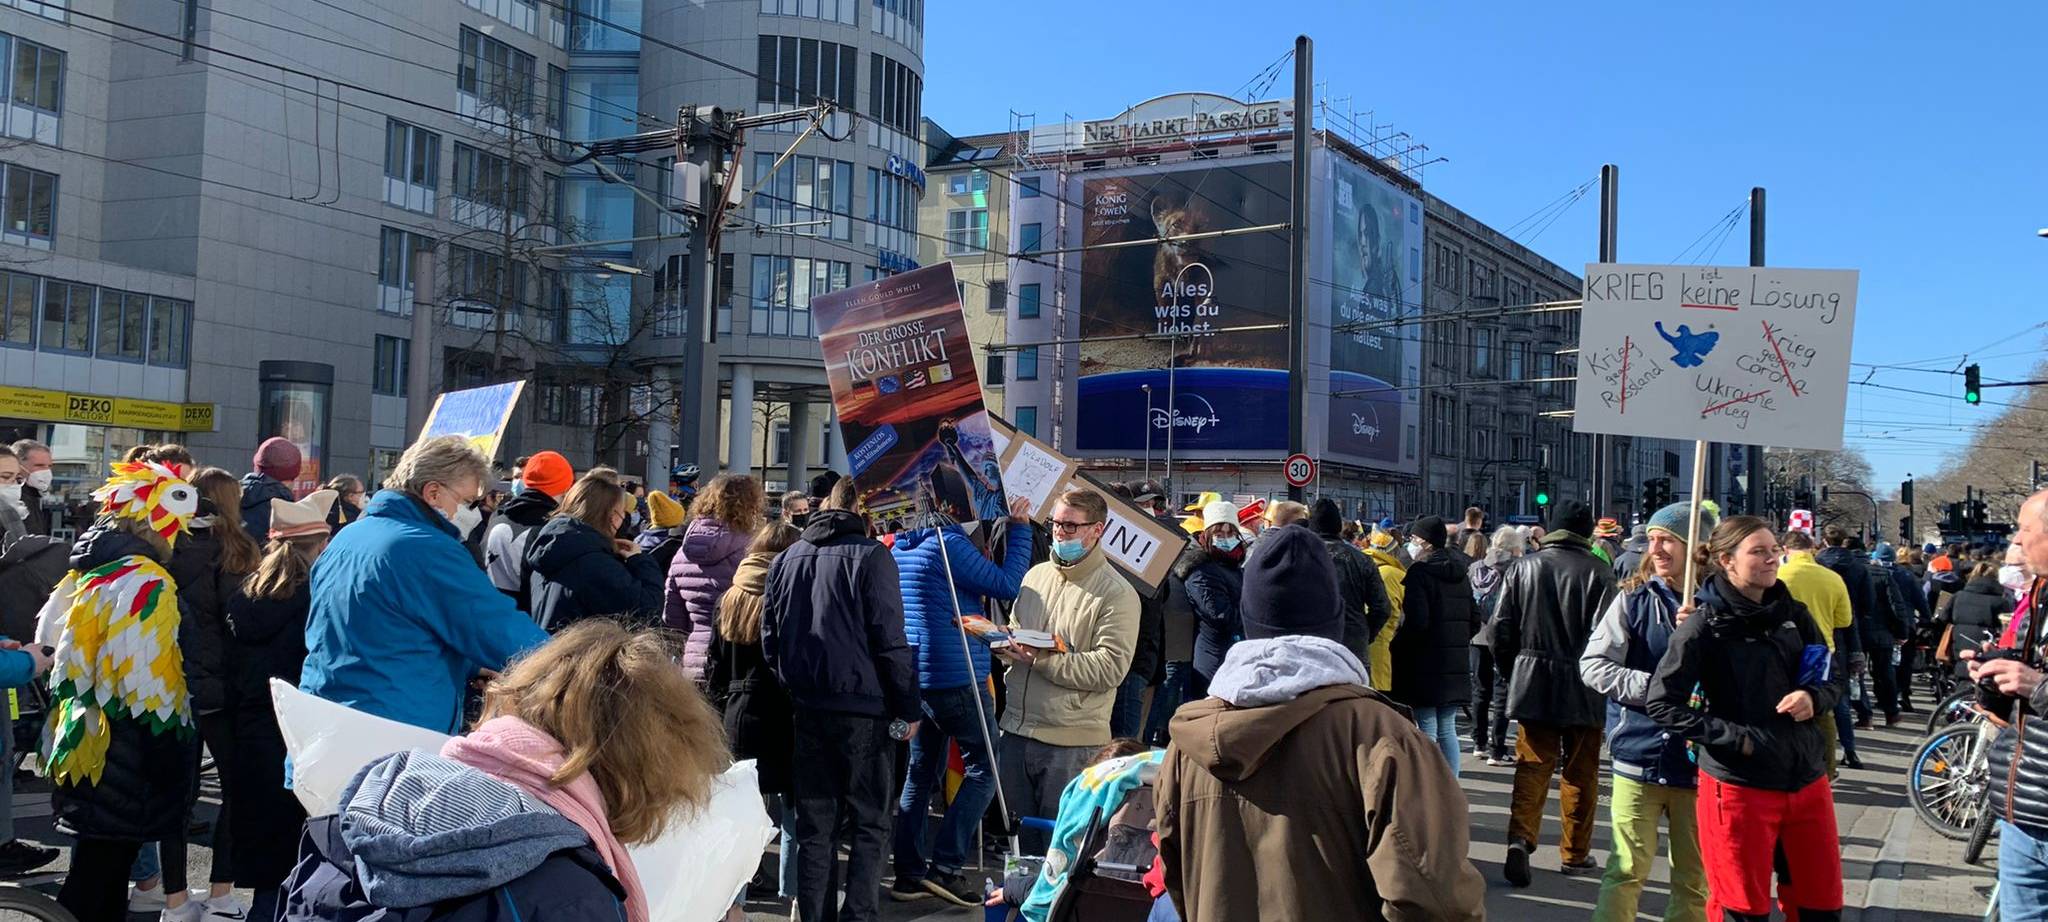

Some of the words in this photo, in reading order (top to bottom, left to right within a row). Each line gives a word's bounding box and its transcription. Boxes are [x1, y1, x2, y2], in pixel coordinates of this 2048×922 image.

[1084, 118, 1188, 142] NEUMARKT
[1194, 107, 1279, 131] PASSAGE
[1587, 271, 1664, 301] KRIEG
[1700, 268, 1724, 281] ist
[868, 290, 894, 301] GOULD
[896, 282, 921, 294] WHITE
[1681, 272, 1740, 306] keine
[1750, 274, 1841, 324] Lösung
[1154, 304, 1191, 318] was
[1196, 301, 1219, 316] du
[1340, 302, 1351, 319] du
[858, 332, 881, 348] DER
[883, 320, 926, 341] GROSSE
[1761, 323, 1817, 367] Krieg
[846, 328, 949, 381] KONFLIKT
[1585, 341, 1644, 376] Krieg
[1755, 348, 1796, 370] gegen
[1600, 358, 1664, 408] Russland
[1605, 362, 1633, 386] gegen
[1735, 354, 1809, 395] Corona
[69, 397, 111, 414] DEKO
[1696, 373, 1776, 411] Ukraine
[69, 412, 111, 422] FACTORY
[185, 408, 212, 419] DEKO
[1150, 408, 1220, 434] Disney+
[1704, 399, 1750, 429] Krieg
[853, 431, 885, 460] KOSTENLOS
[1290, 463, 1309, 478] 30
